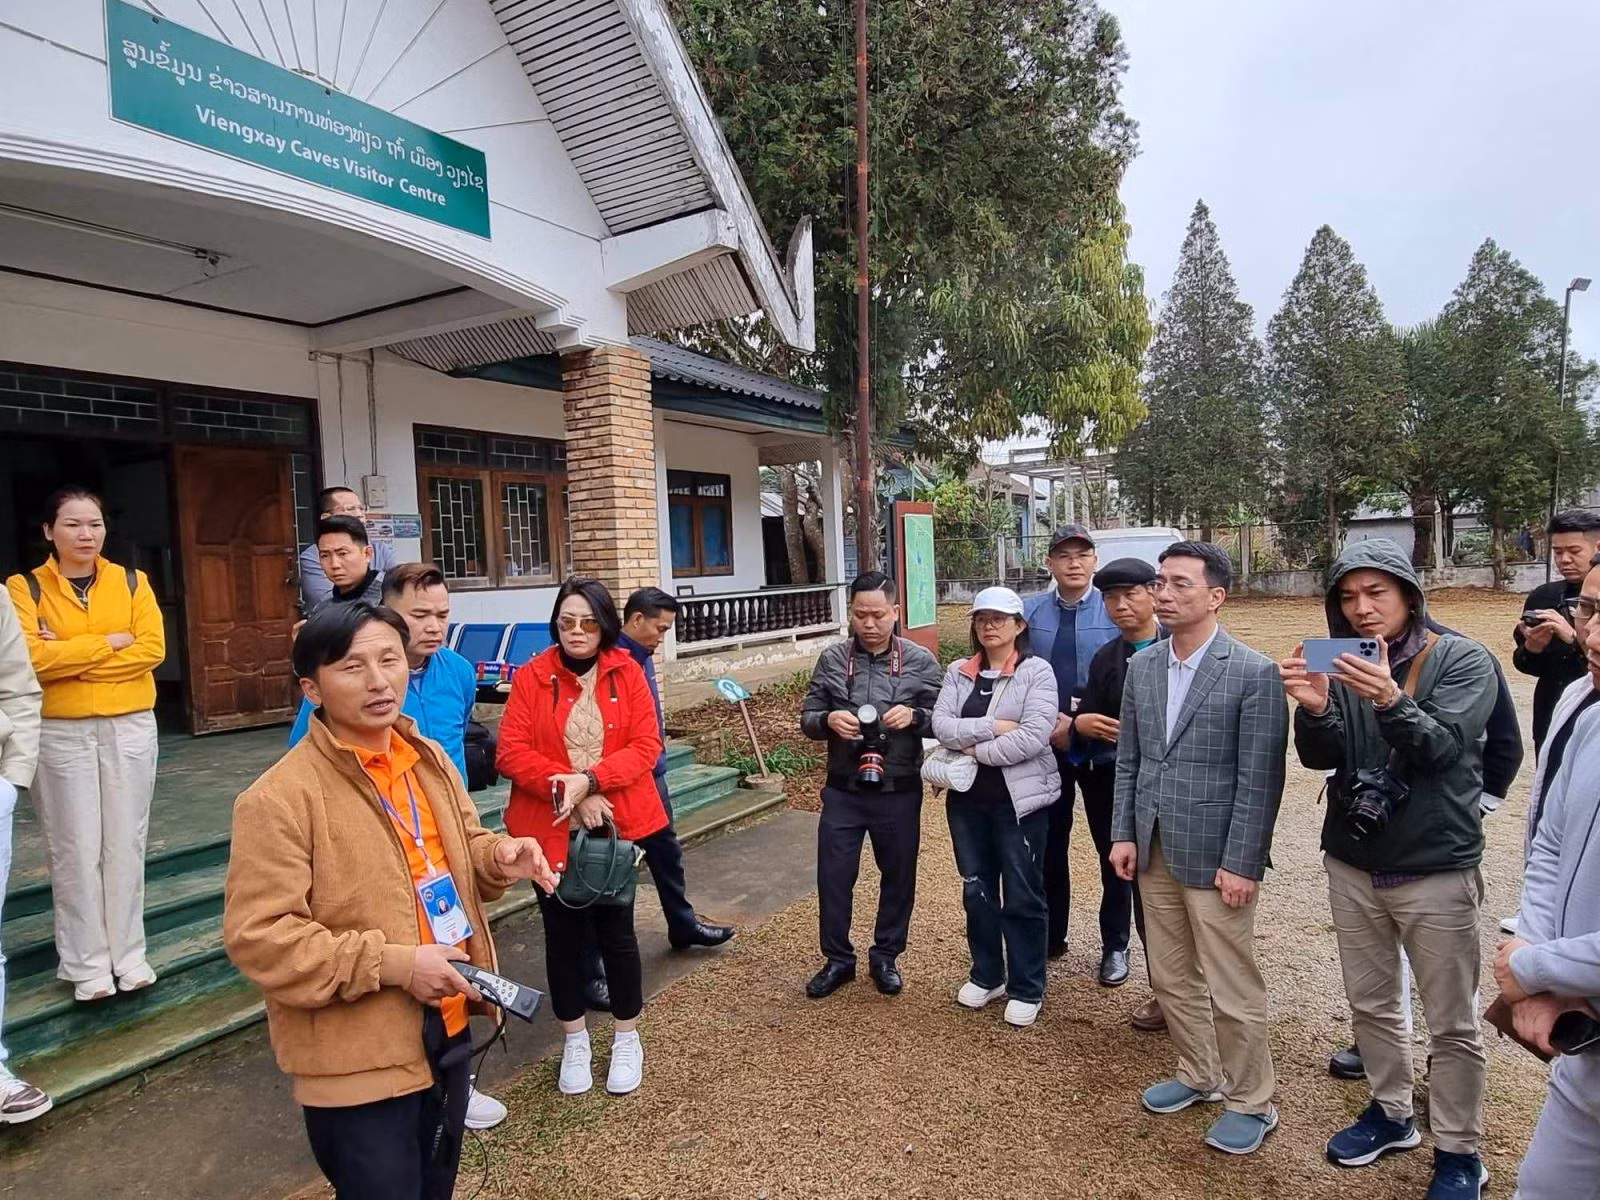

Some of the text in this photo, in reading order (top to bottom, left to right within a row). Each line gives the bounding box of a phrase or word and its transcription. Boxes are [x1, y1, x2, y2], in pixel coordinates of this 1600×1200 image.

[196, 104, 446, 206] Viengxay Caves Visitor Centre
